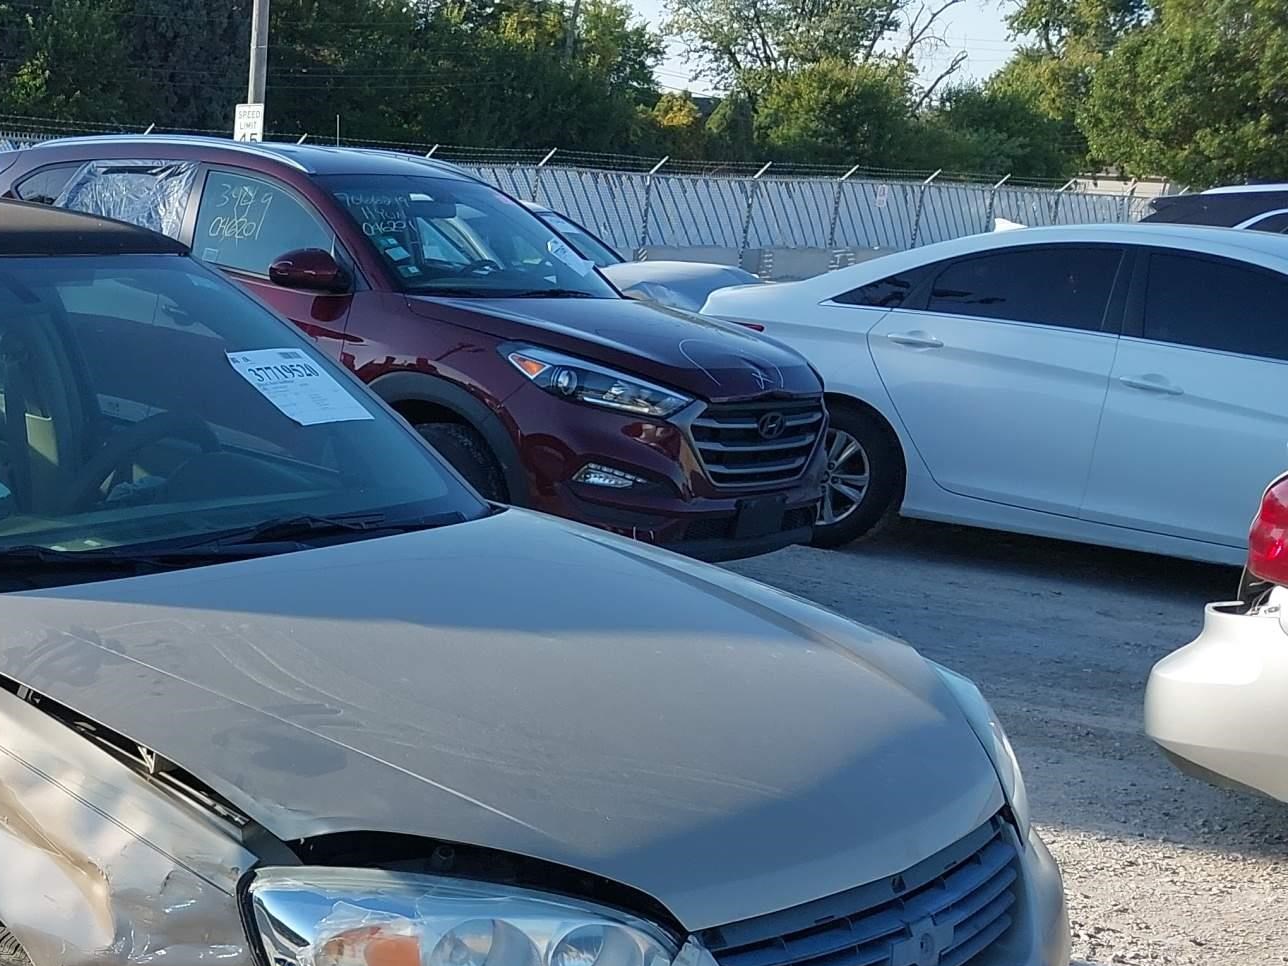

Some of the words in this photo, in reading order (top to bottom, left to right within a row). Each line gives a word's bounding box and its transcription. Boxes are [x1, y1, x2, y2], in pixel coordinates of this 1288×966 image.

[238, 110, 261, 119] SPEED
[239, 121, 257, 130] LIMIT
[248, 363, 320, 382] 37719520
